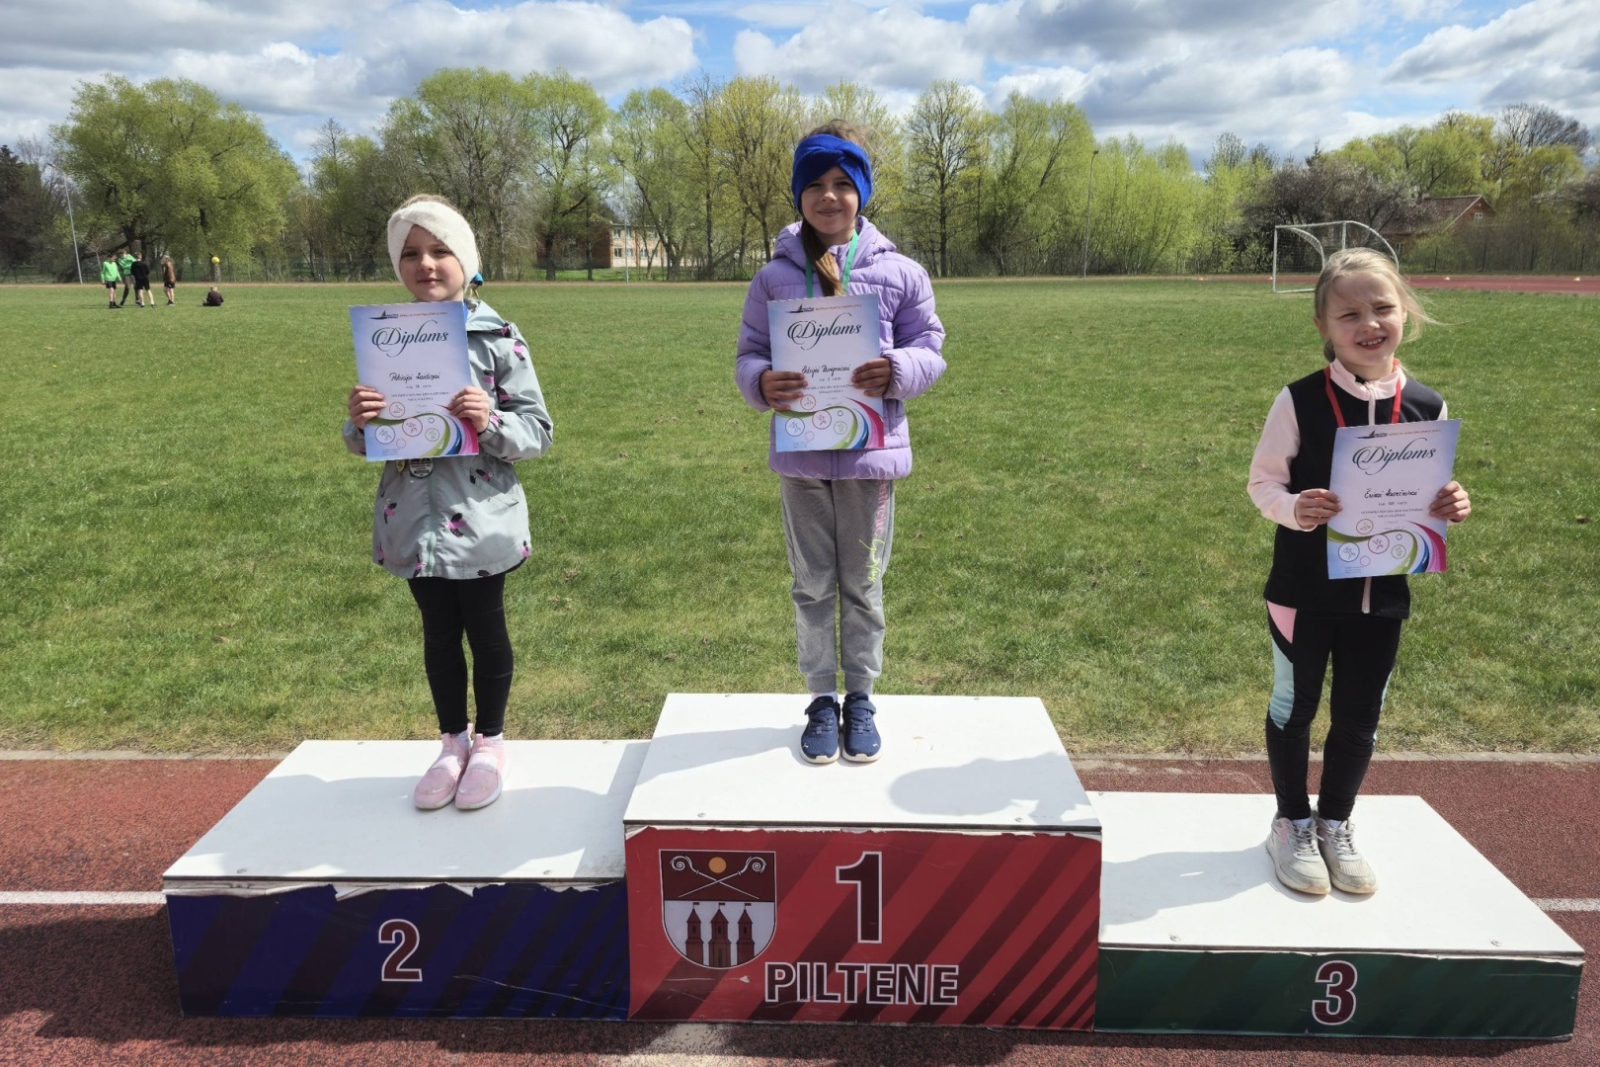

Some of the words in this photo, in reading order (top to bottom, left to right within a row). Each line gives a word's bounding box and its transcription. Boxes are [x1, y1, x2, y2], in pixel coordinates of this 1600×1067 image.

[371, 319, 449, 358] Diploms
[787, 312, 862, 351] Diploms
[1352, 437, 1437, 475] Diploms
[835, 851, 882, 944] 1
[378, 918, 423, 982] 2
[764, 961, 960, 1006] PILTENE
[1311, 959, 1358, 1026] 3
